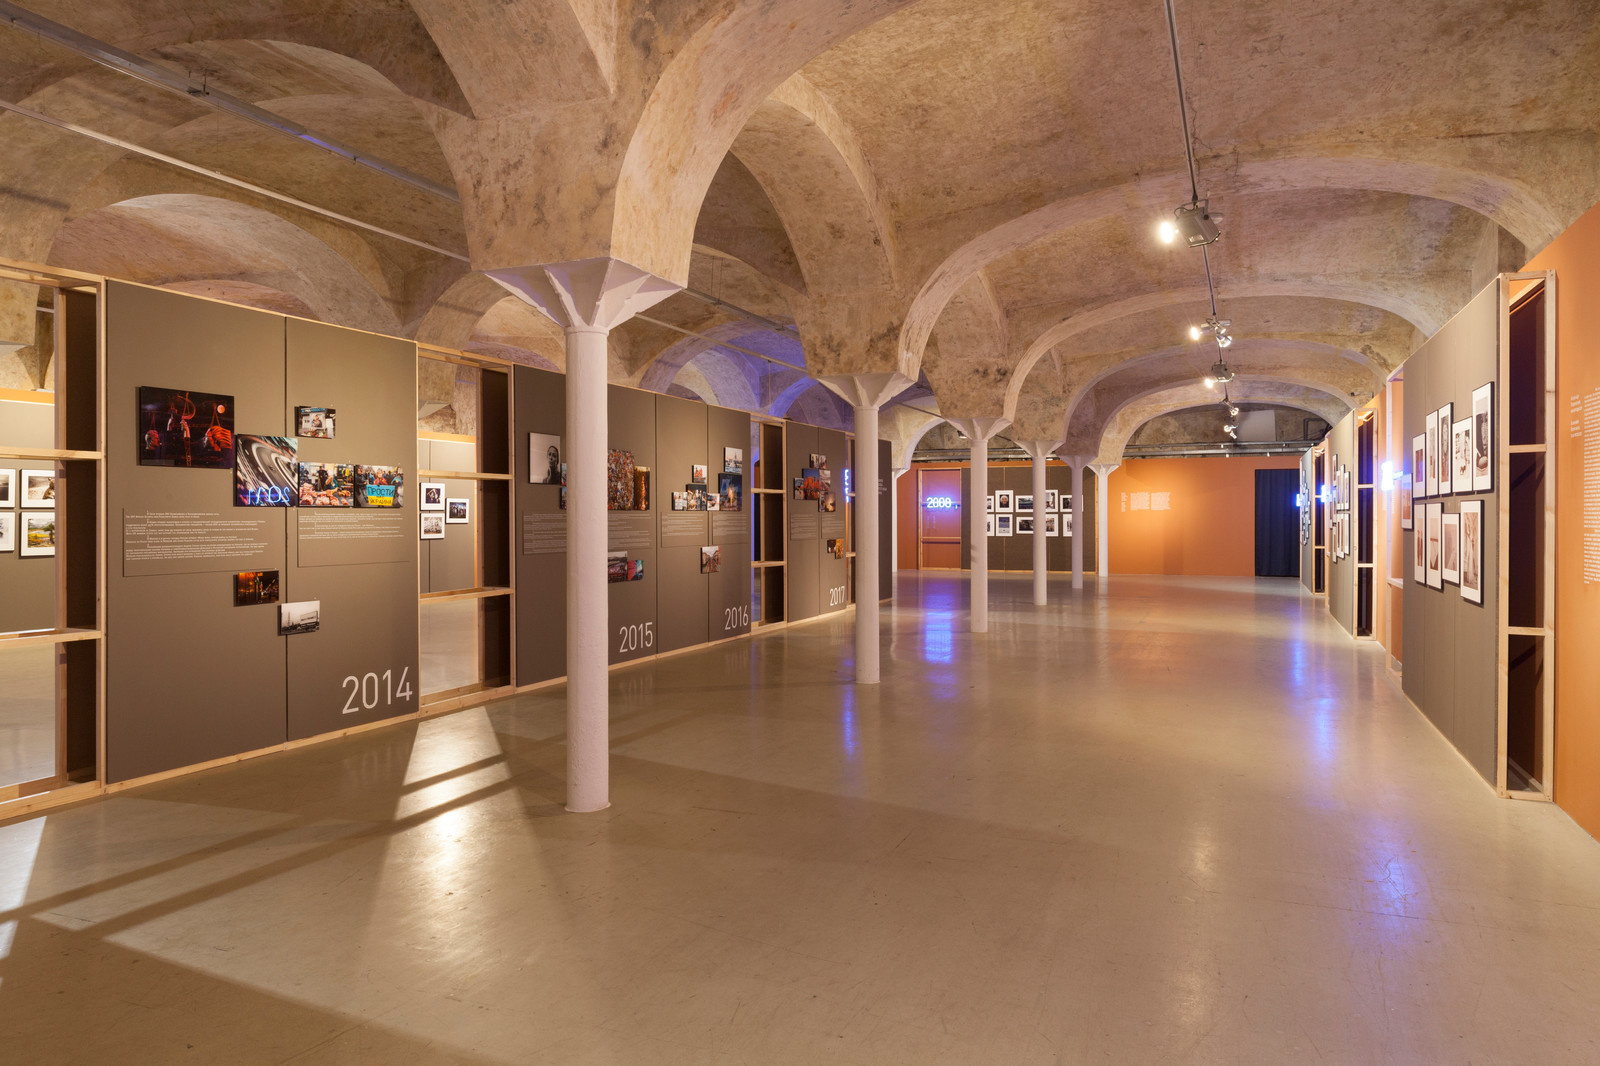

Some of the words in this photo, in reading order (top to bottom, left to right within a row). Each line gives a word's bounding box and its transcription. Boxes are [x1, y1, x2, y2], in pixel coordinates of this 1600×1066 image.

[367, 486, 394, 496] ПРОСТИ
[926, 497, 952, 508] 2008
[829, 585, 845, 606] 2017
[724, 605, 749, 631] 2016
[619, 621, 654, 653] 2015
[341, 666, 413, 715] 2014
